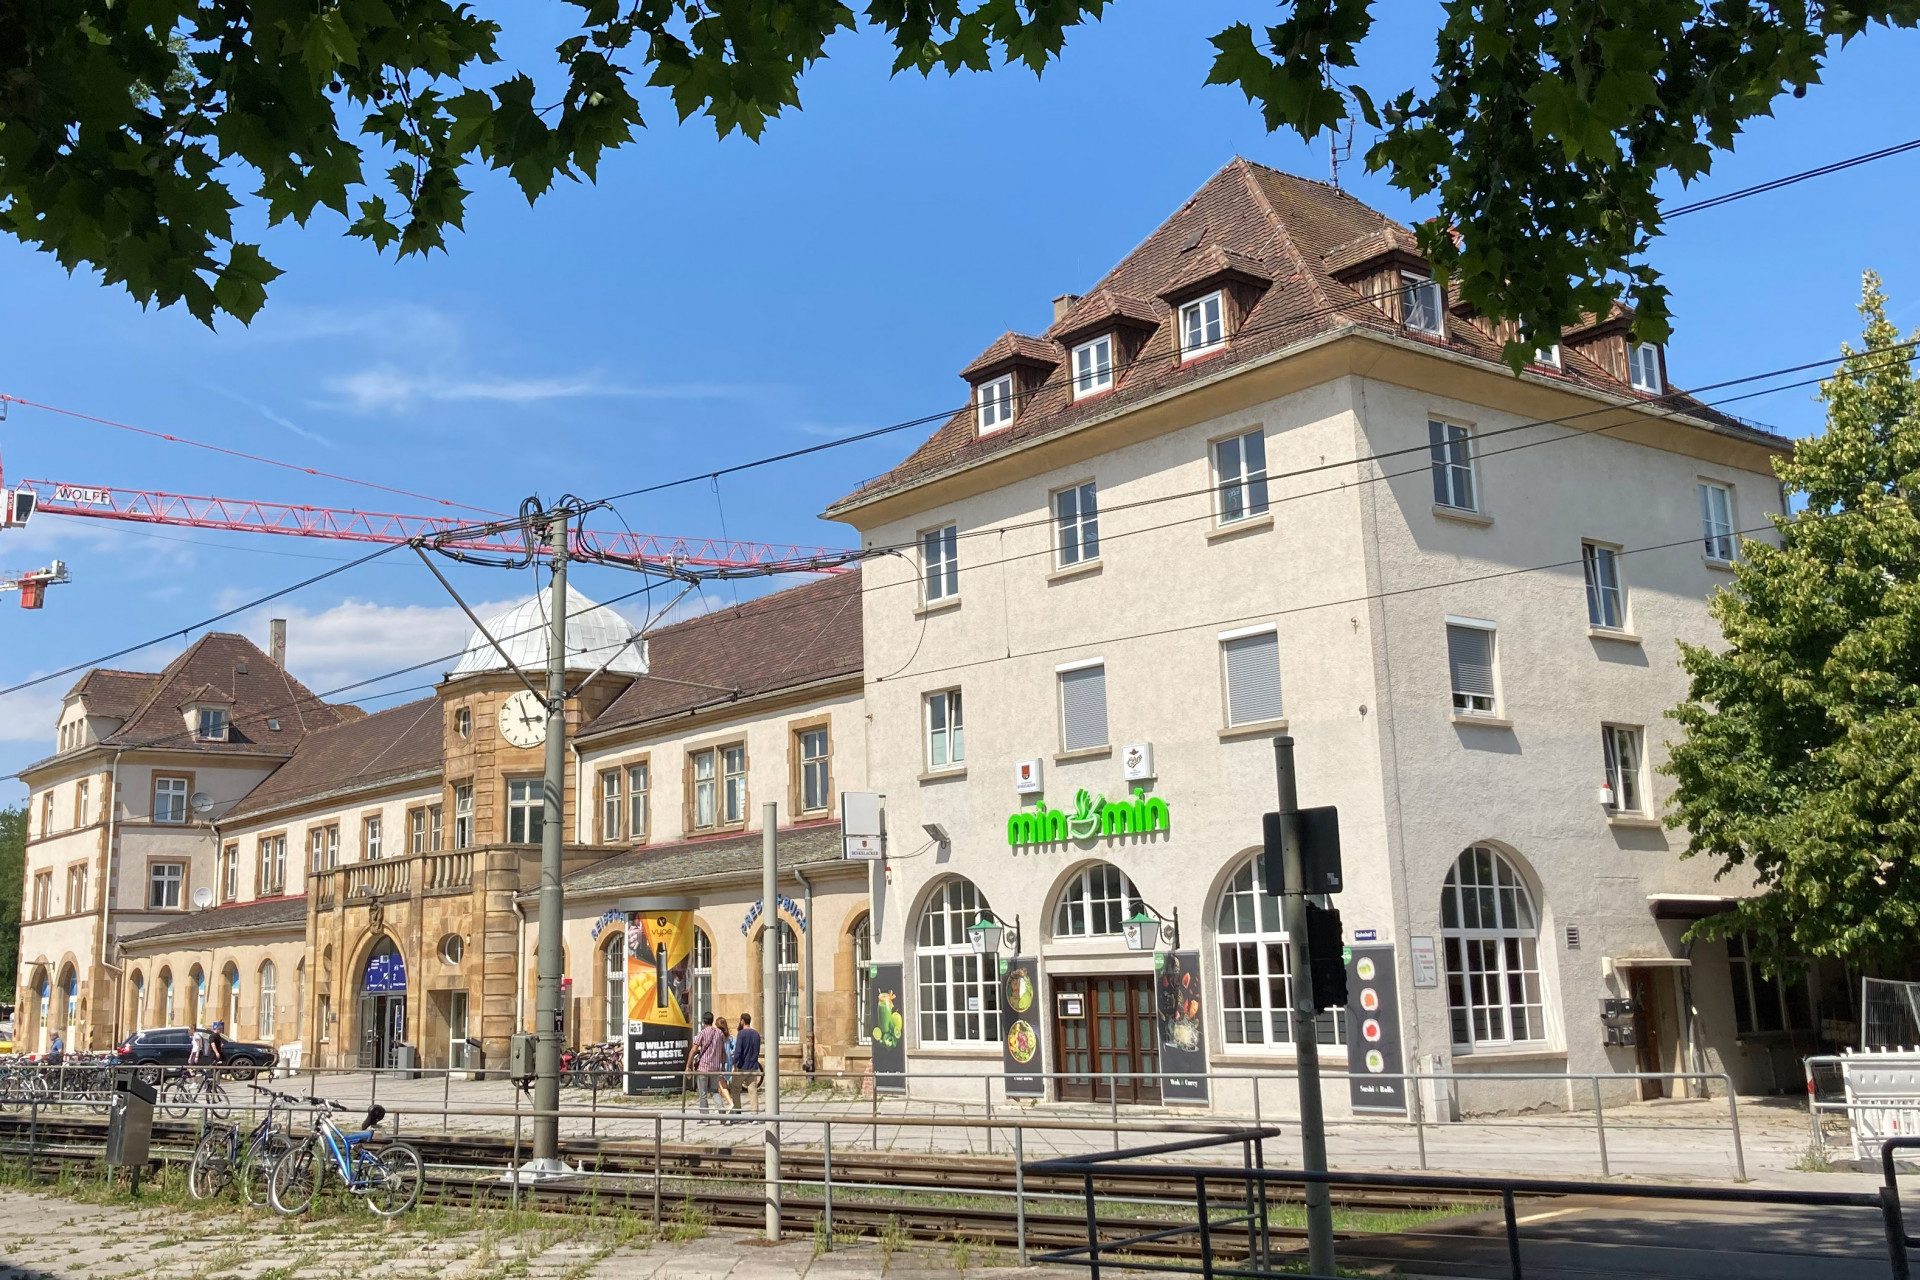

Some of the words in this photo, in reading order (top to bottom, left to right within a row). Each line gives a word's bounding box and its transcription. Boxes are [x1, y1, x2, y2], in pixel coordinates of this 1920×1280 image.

[60, 488, 109, 503] WOLFF
[1007, 799, 1068, 846] min
[1101, 787, 1170, 837] min
[651, 928, 673, 938] vype
[635, 1042, 645, 1050] DU
[646, 1041, 674, 1049] WILLST
[641, 1050, 657, 1059] DAS
[659, 1050, 684, 1058] BESTE.
